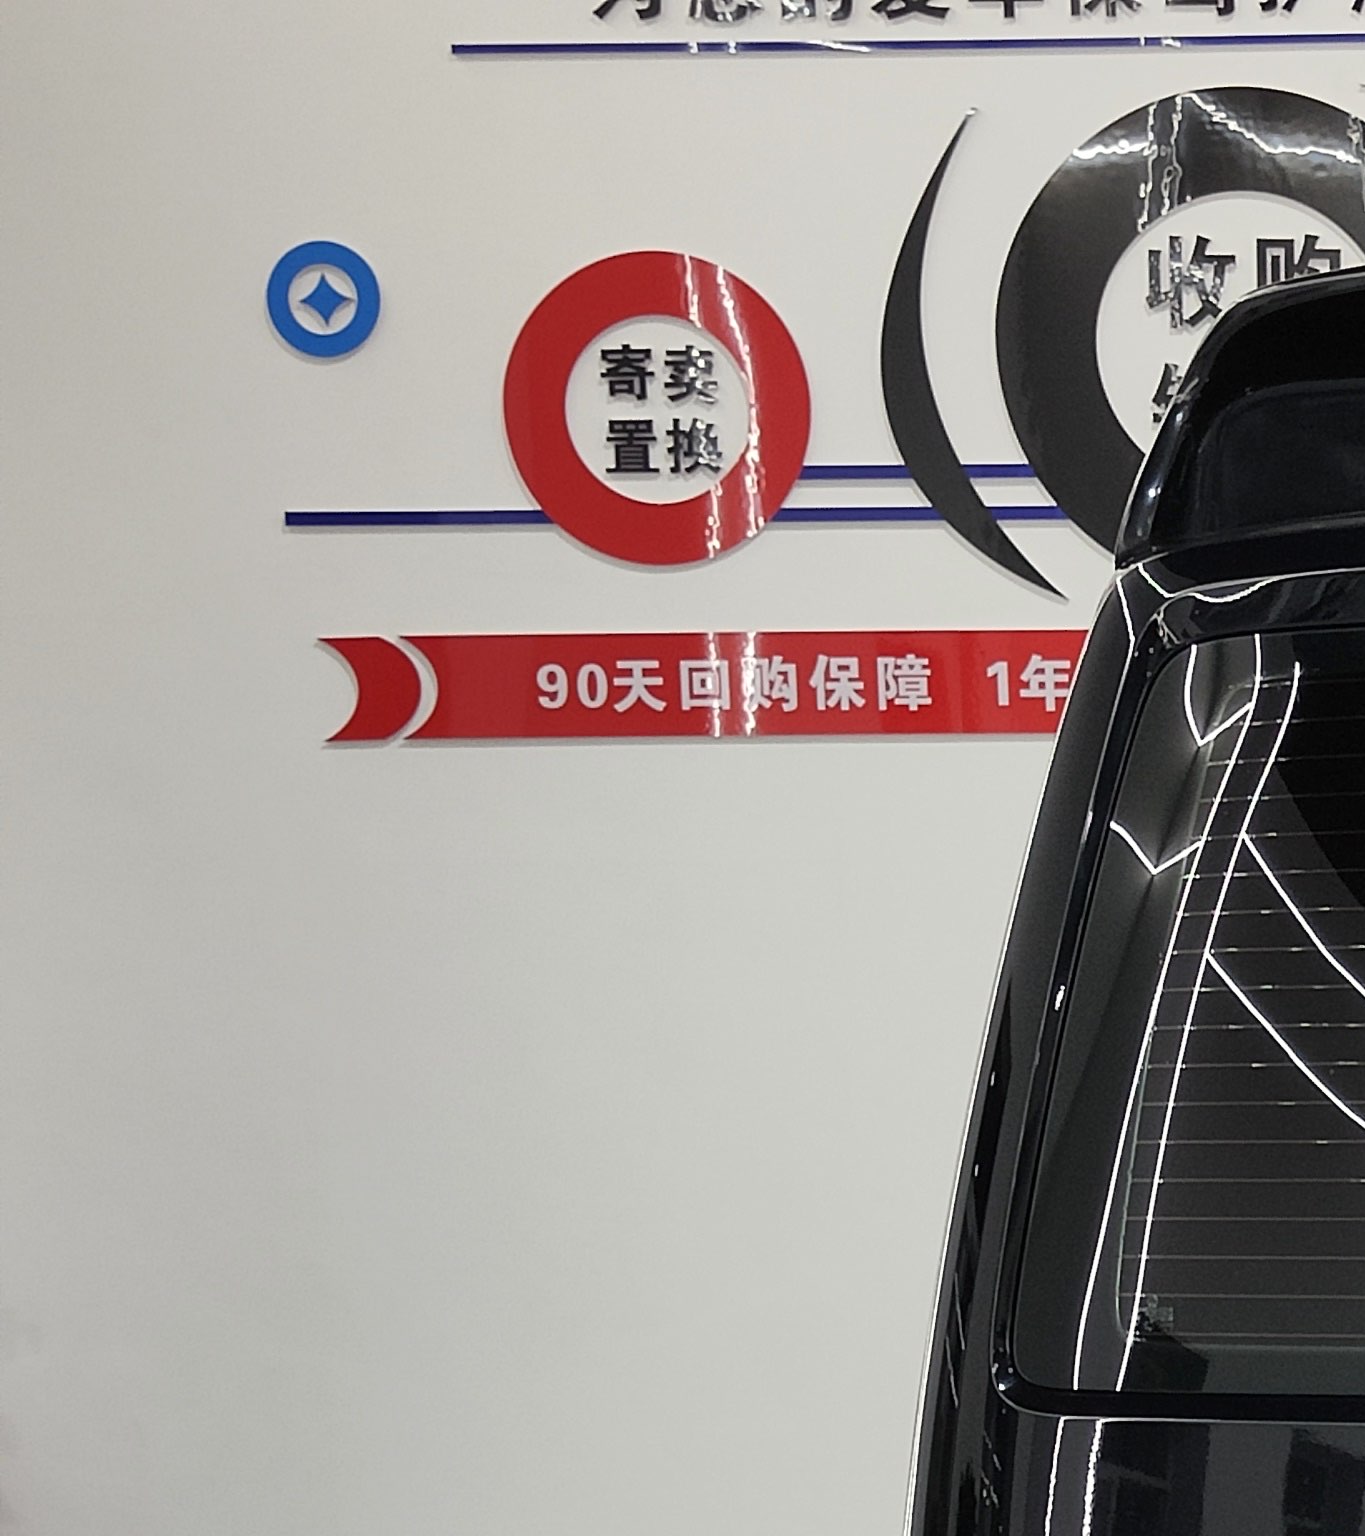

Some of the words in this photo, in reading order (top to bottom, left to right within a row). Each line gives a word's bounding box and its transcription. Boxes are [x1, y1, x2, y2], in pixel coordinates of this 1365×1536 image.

[600, 344, 718, 403] 寄卖
[606, 418, 723, 473] 置换
[536, 654, 932, 713] 90天回购保障
